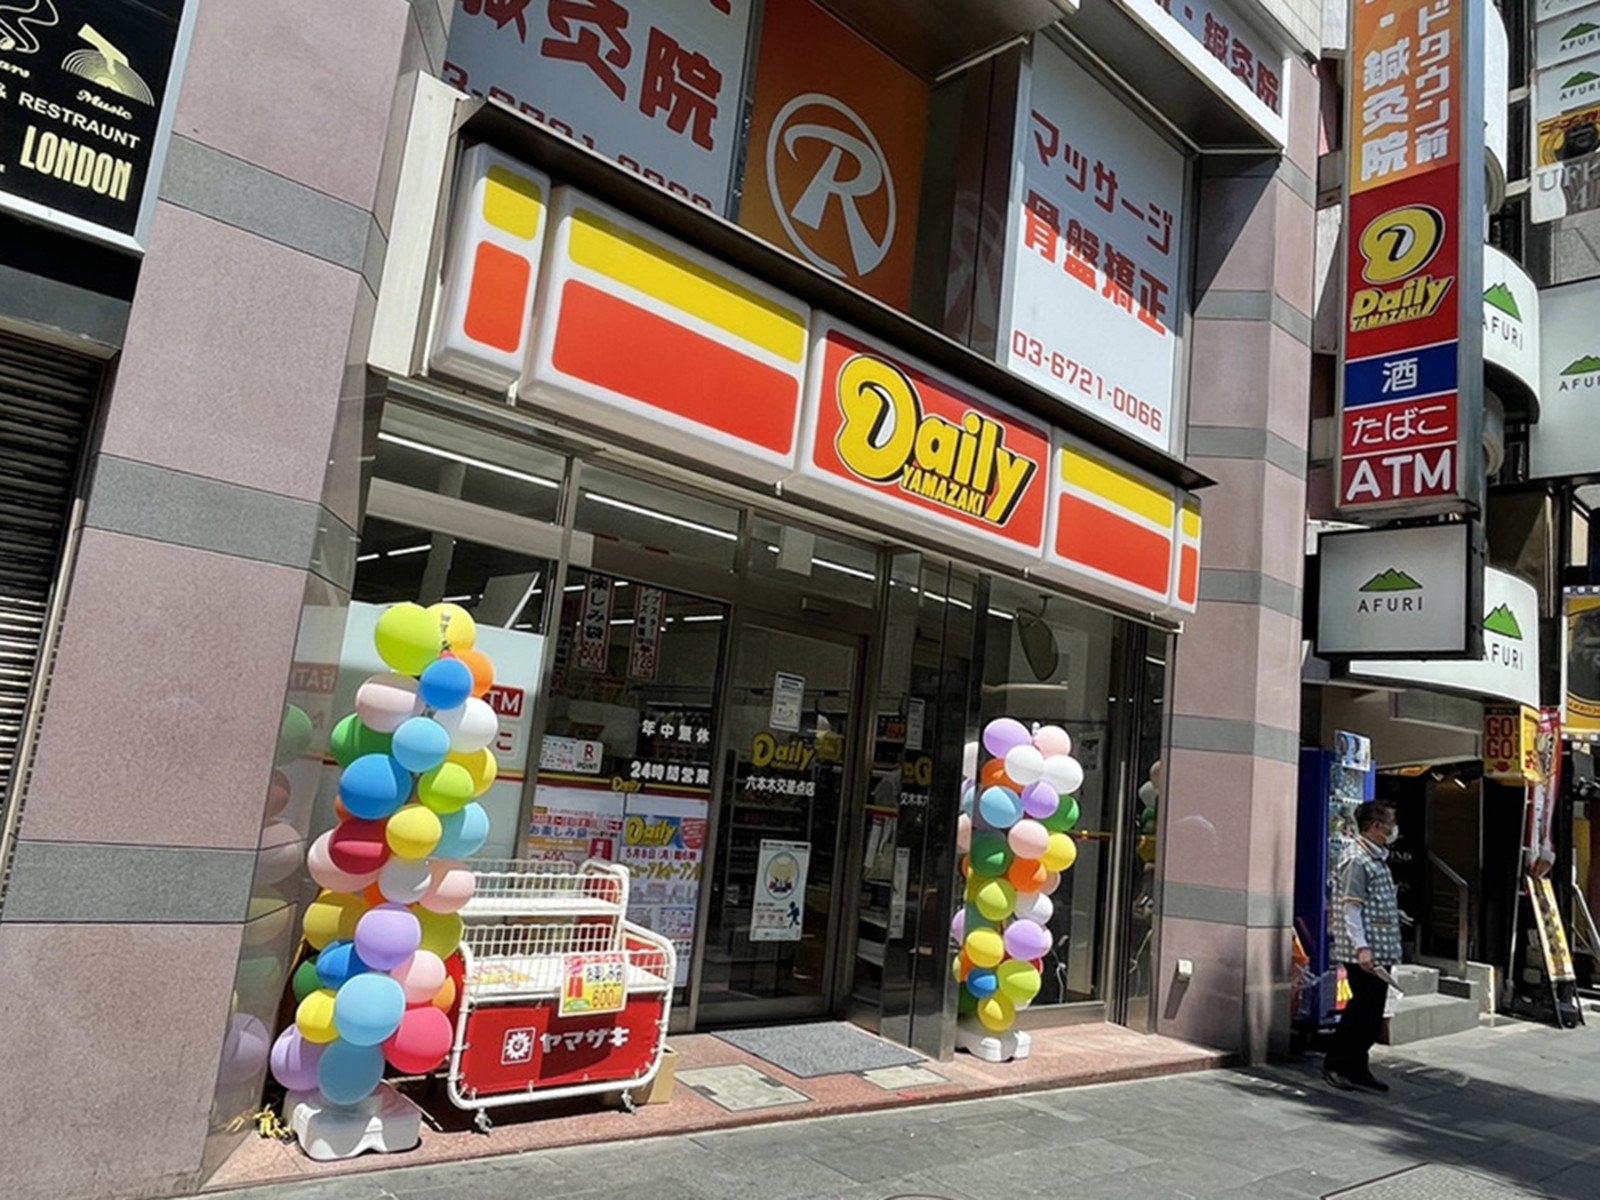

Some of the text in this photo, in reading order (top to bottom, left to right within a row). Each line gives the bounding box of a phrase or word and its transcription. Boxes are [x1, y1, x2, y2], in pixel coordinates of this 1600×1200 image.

[18, 91, 141, 149] RESTRAUNT
[76, 89, 133, 121] Music
[19, 124, 133, 202] LONDON
[1031, 110, 1174, 255] マッサージ
[1024, 189, 1170, 337] 骨盤矯正
[1351, 275, 1453, 318] Daily
[1351, 304, 1426, 332] YAMAZAKI
[1012, 329, 1163, 433] 03-6721-0066
[1382, 356, 1419, 393] 酒
[836, 355, 1036, 525] Daily
[1352, 404, 1449, 447] たばこ
[902, 464, 987, 517] YAMAZAKI
[1346, 448, 1451, 501] ATM
[1357, 597, 1423, 613] AFURI
[487, 690, 521, 713] TM
[641, 720, 711, 743] 年中無休
[576, 762, 598, 773] POINT
[752, 732, 815, 771] Daily
[630, 761, 710, 784] 24時間営業
[624, 816, 677, 847] Daily
[540, 1026, 630, 1054] ヤマザキ
